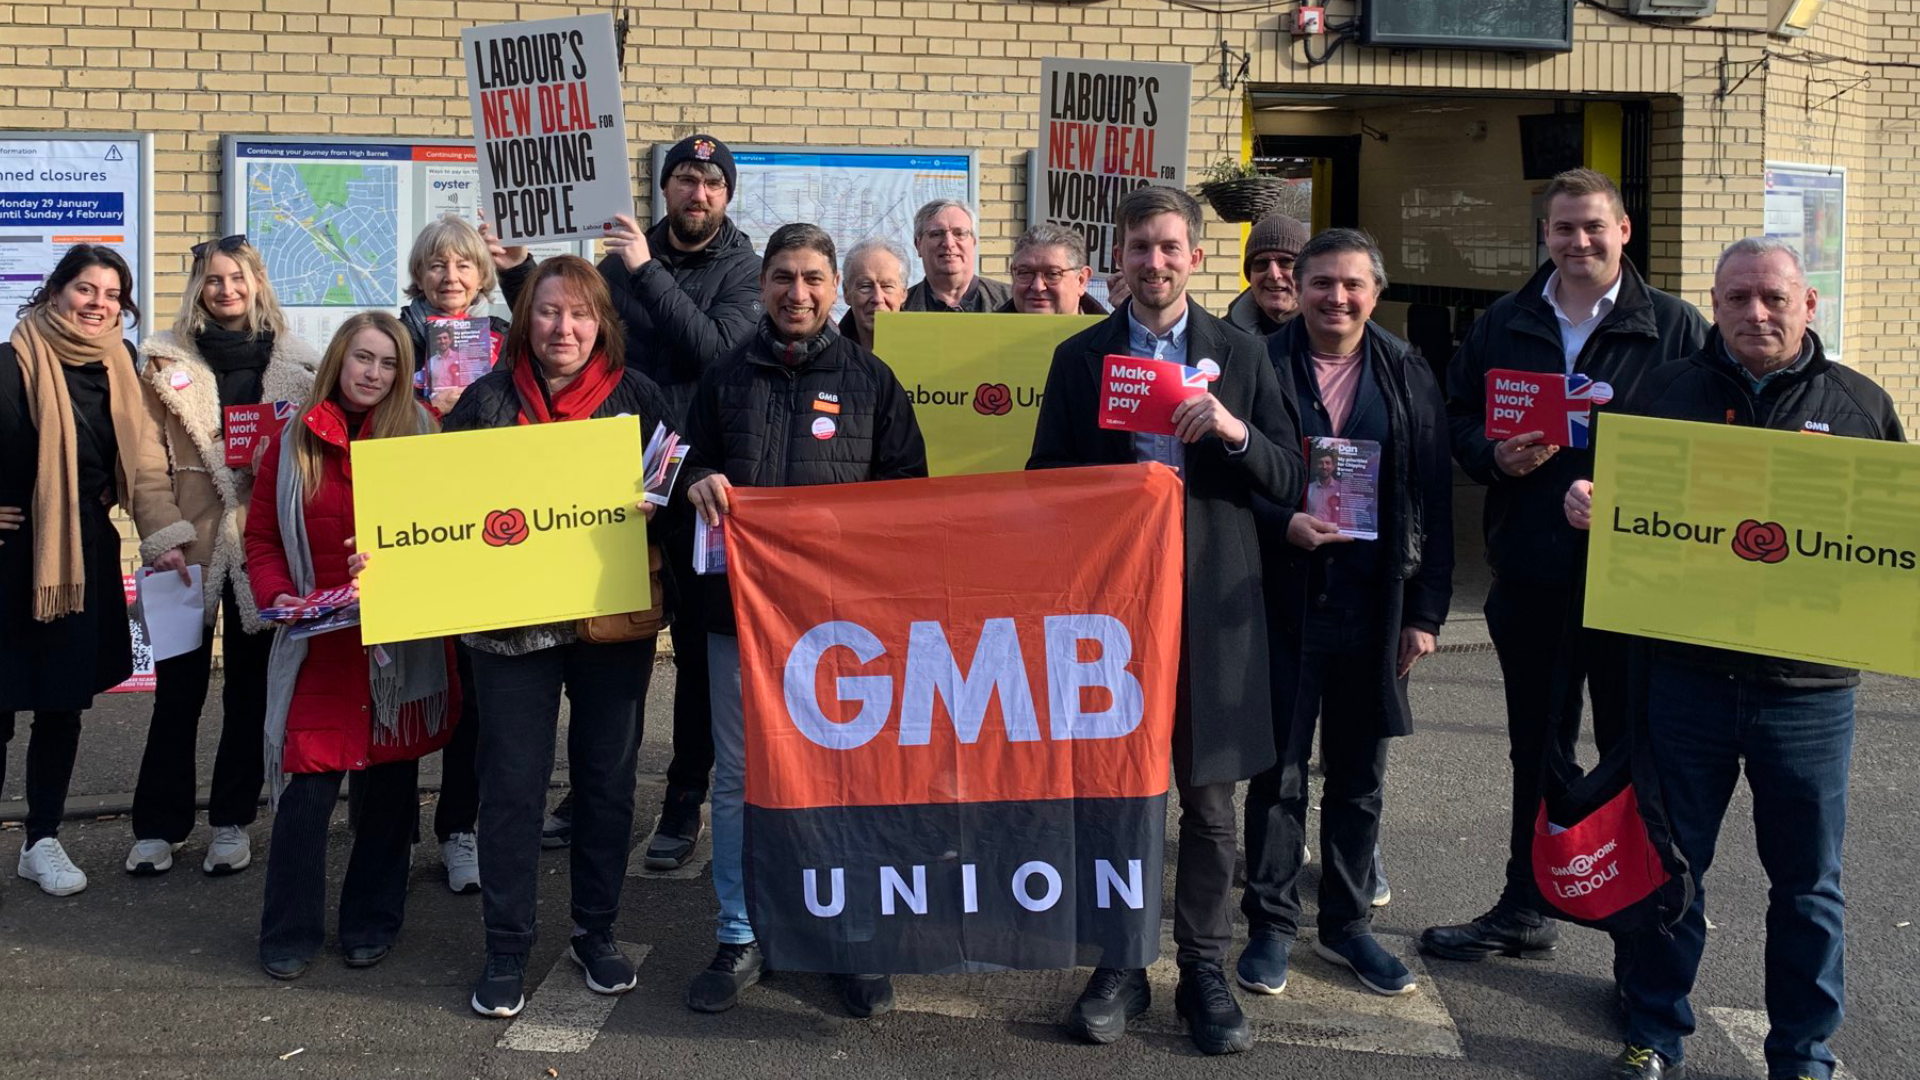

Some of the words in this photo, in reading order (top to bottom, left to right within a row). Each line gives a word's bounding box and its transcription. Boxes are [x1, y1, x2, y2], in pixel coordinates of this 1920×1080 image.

[475, 30, 587, 89] LABOUR'S
[1051, 71, 1159, 126] LABOUR'S
[480, 87, 532, 140] NEW
[538, 81, 597, 135] DEAL
[599, 115, 614, 128] FOR
[247, 147, 285, 156] Continuing
[285, 148, 302, 157] your
[302, 148, 329, 157] journey
[330, 148, 348, 157] from
[349, 149, 365, 158] High
[426, 151, 462, 159] Continuing
[1050, 121, 1098, 172] NEW
[1104, 125, 1158, 178] DEAL
[1161, 166, 1176, 180] FOR
[486, 132, 596, 189] WORKING
[40, 169, 107, 181] closures
[433, 180, 470, 191] oyster
[41, 199, 54, 208] 29
[56, 199, 99, 209] January
[1048, 170, 1150, 225] WORKI
[24, 210, 63, 220] Sunday
[66, 210, 73, 219] 4
[76, 210, 123, 220] February
[493, 185, 577, 239] PEOPLE
[1111, 364, 1157, 381] Make
[1109, 382, 1151, 396] work
[1495, 378, 1540, 394] Make
[818, 391, 839, 403] GMB
[908, 384, 968, 405] abour
[1494, 394, 1534, 408] work
[1108, 396, 1141, 413] pay
[229, 411, 260, 422] Make
[1493, 407, 1525, 423] pay
[229, 422, 258, 434] work
[1805, 420, 1830, 432] GMB
[229, 436, 252, 449] pay
[1339, 444, 1358, 453] Dan
[377, 520, 476, 549] Labour
[533, 504, 626, 531] Unions
[1613, 506, 1726, 545] Labour
[1796, 528, 1917, 570] Unions
[783, 613, 1145, 750] GMB
[1553, 860, 1620, 898] Labour
[802, 857, 1145, 918] UNION
